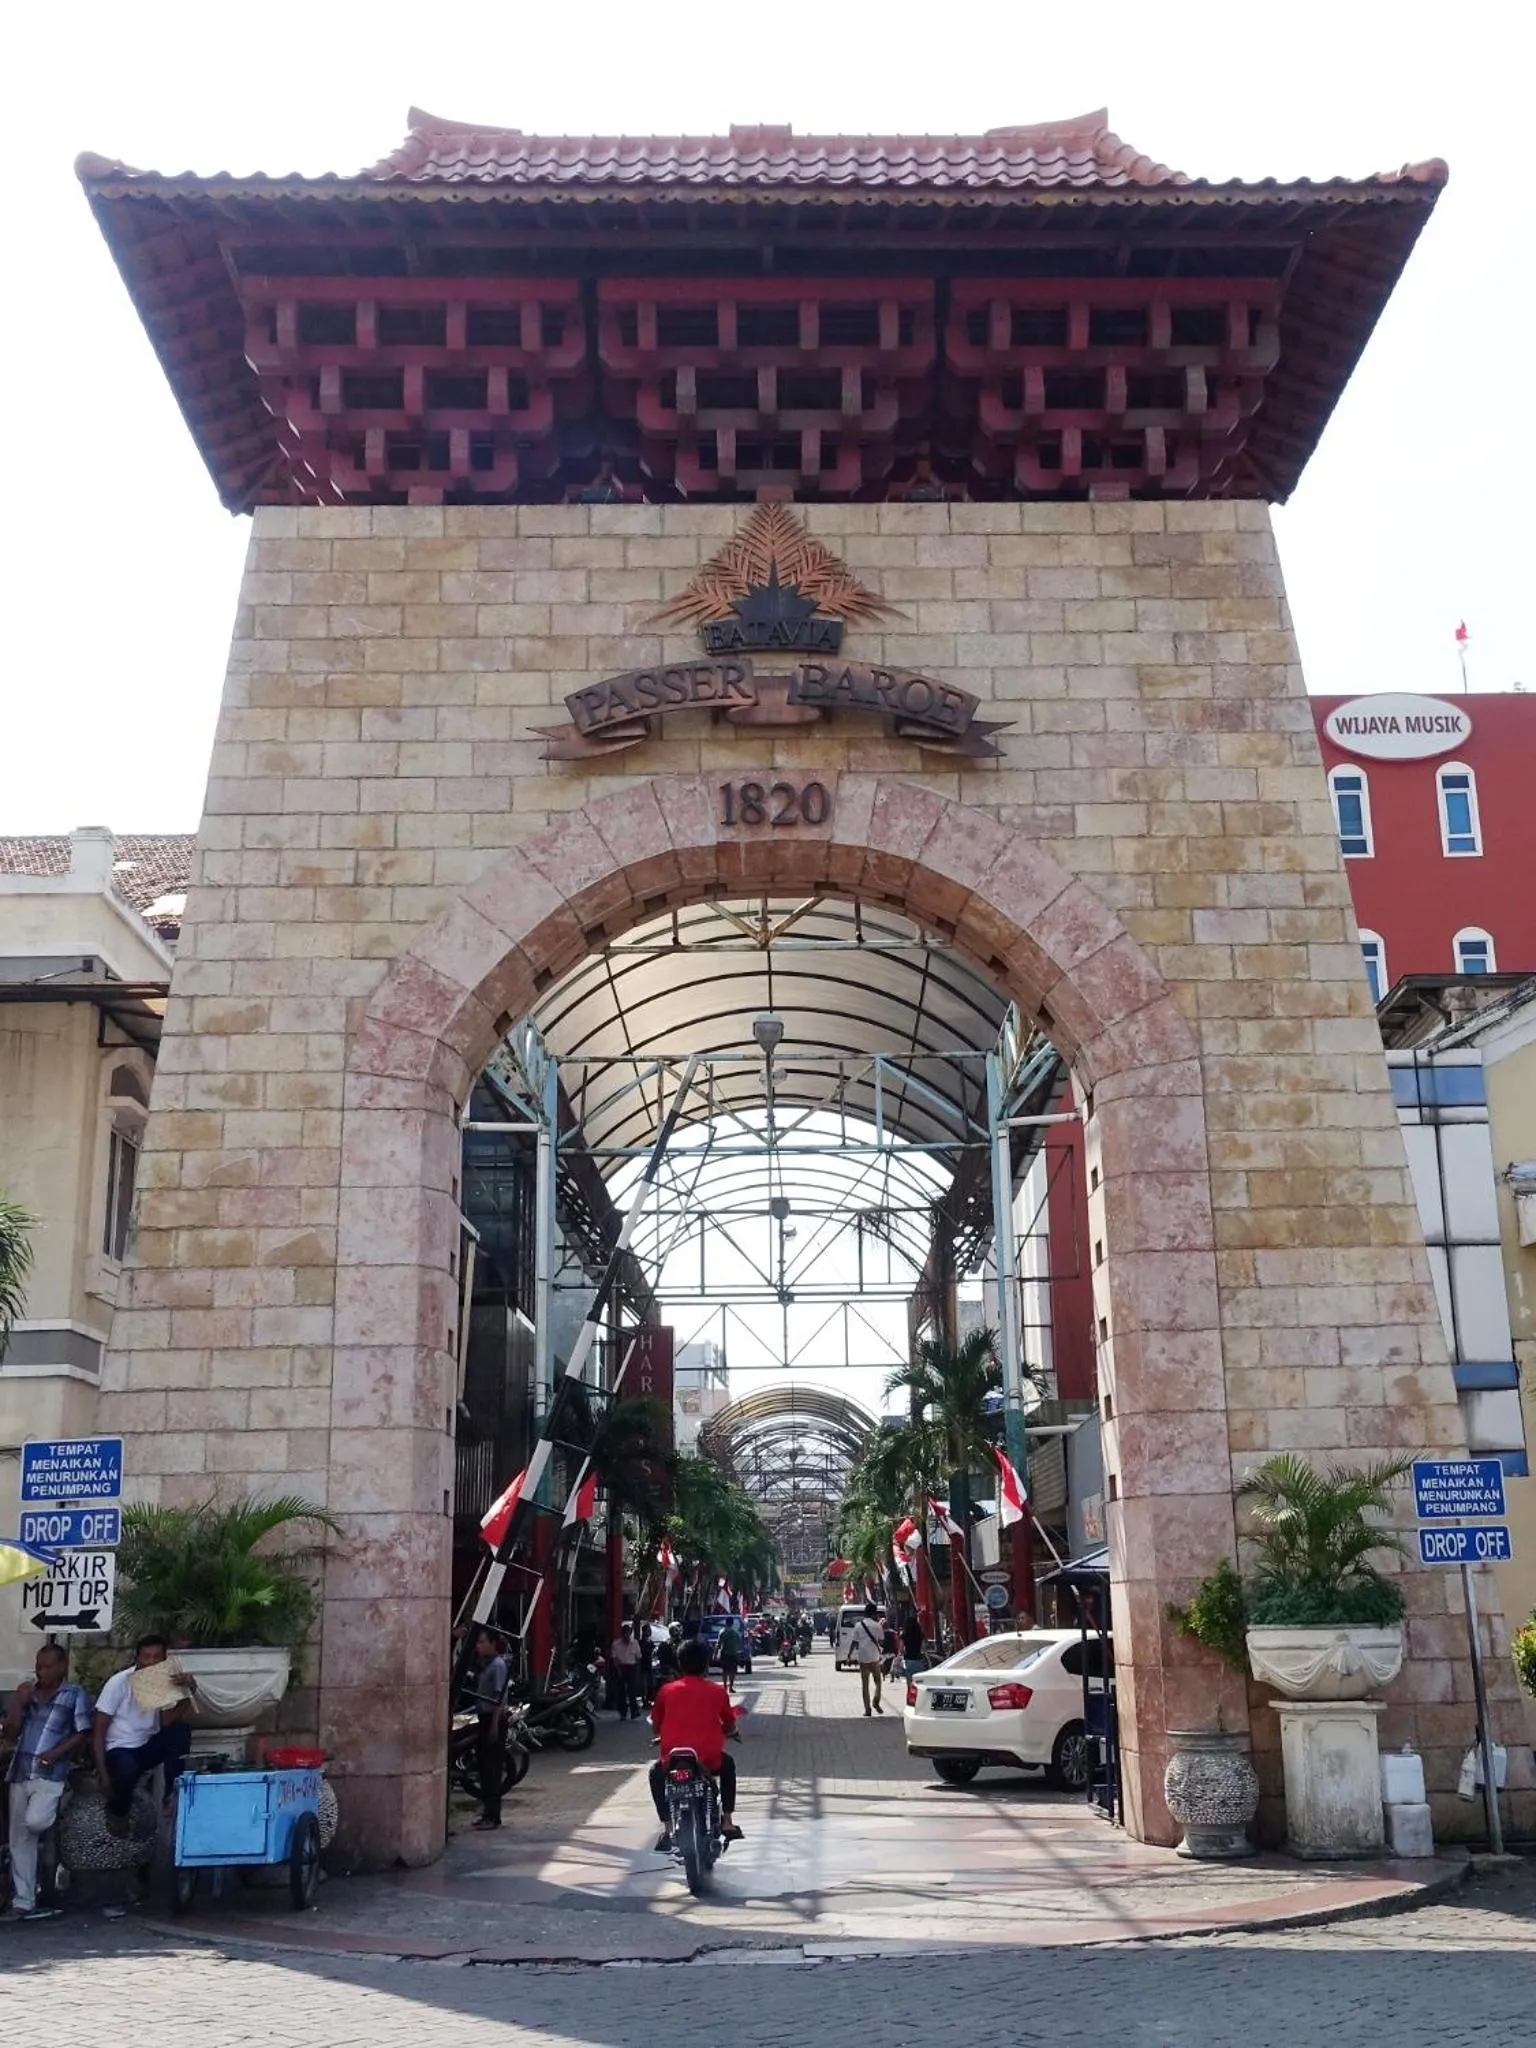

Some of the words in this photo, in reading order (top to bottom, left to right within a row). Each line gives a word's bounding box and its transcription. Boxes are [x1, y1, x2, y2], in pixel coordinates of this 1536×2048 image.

[710, 621, 835, 649] BATAVIA
[578, 664, 753, 728] PASSER
[799, 663, 967, 726] BAROE
[1335, 716, 1401, 735] WIJAYA
[1405, 715, 1462, 733] MUSIK
[719, 781, 832, 827] 1820
[48, 1444, 99, 1456] TEMPAT
[31, 1457, 102, 1470] MENAIKAN
[1433, 1464, 1480, 1476] TEMPAT
[26, 1469, 118, 1483] MENURUNKAN
[1422, 1477, 1484, 1489] MENAIKAN
[31, 1482, 112, 1496] PENUMPANG
[1418, 1489, 1501, 1501] MENURUNKAN
[1425, 1501, 1497, 1514] PENUMPANG
[24, 1516, 72, 1543] DROP
[81, 1513, 115, 1540] OFF
[1424, 1532, 1467, 1558] DROP
[1475, 1531, 1505, 1557] OFF
[34, 1554, 107, 1579] RKIR
[22, 1580, 110, 1609] MOTOR
